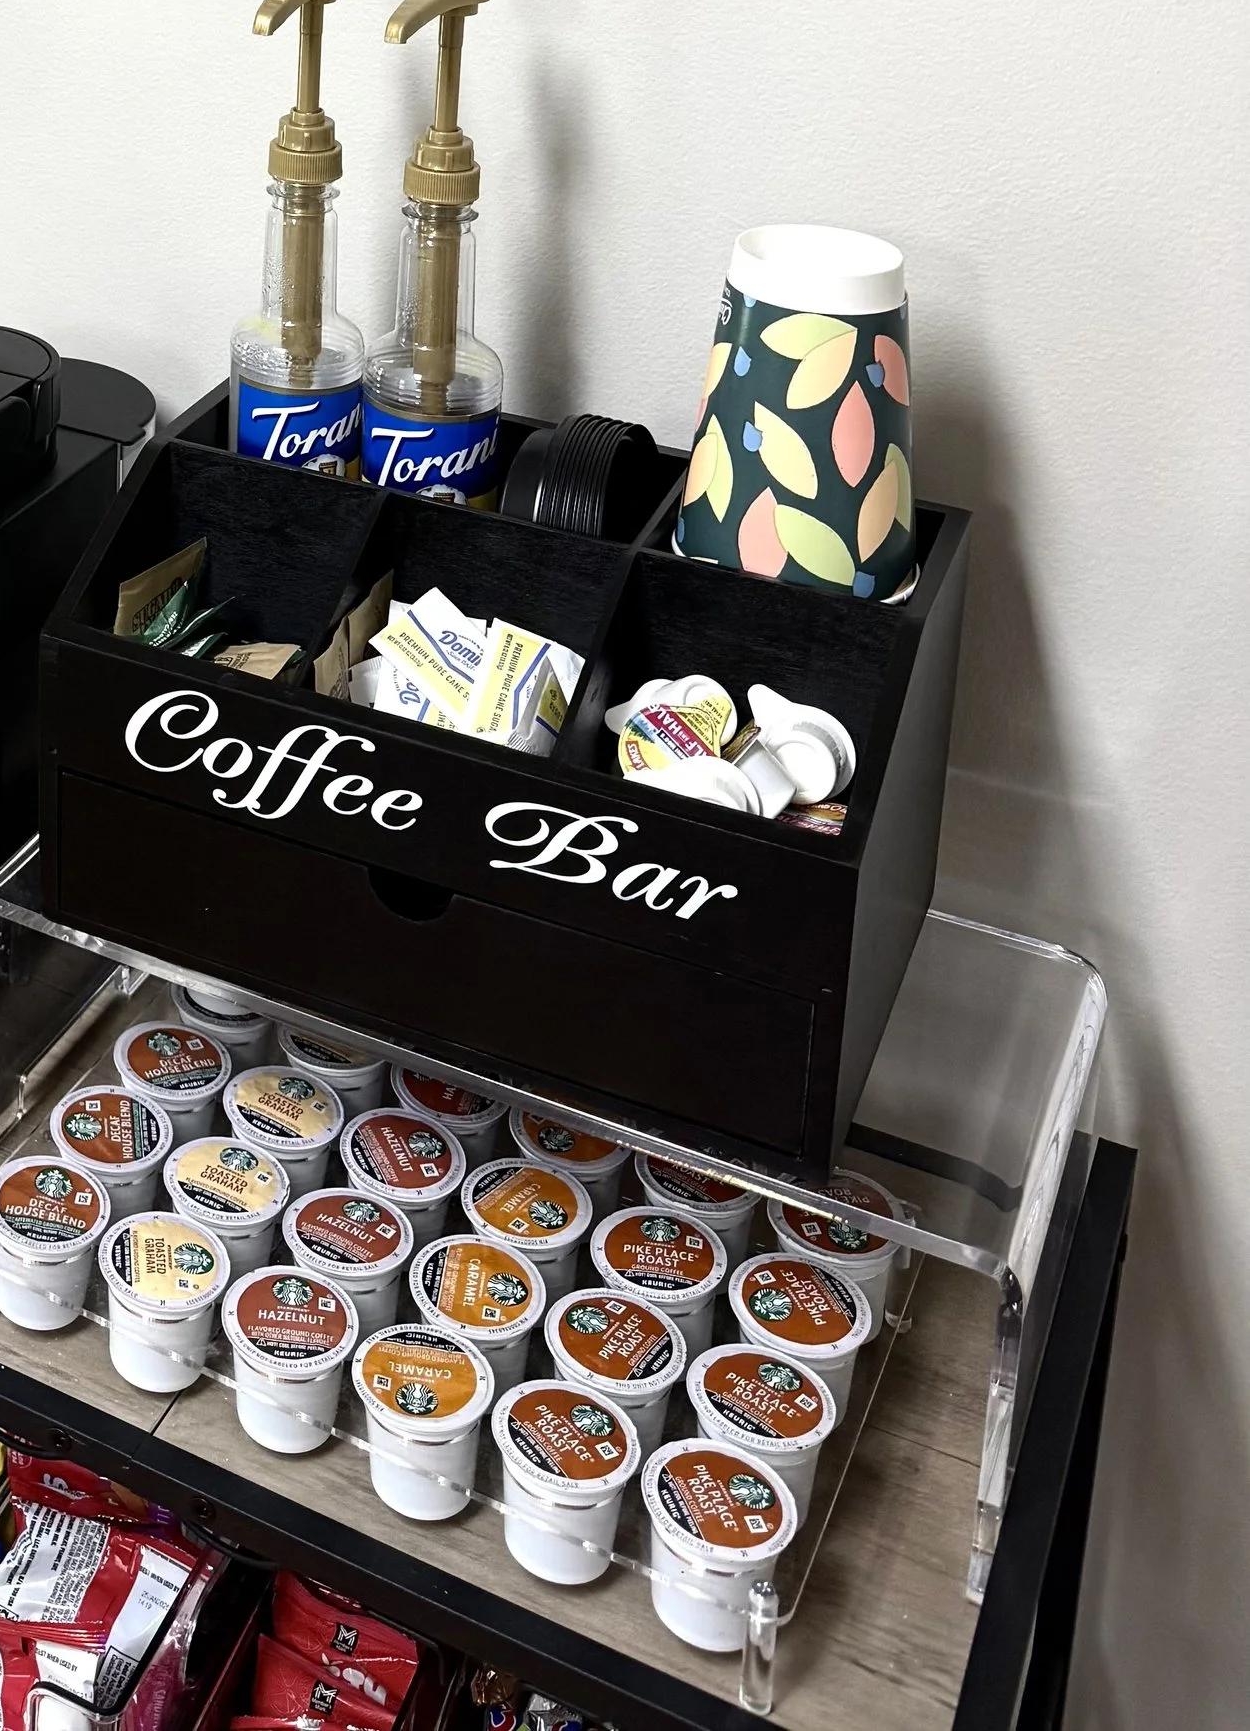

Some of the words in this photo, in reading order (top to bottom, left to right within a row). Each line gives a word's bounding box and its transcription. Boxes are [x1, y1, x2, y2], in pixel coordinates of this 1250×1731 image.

[251, 400, 361, 461] Toran
[371, 416, 499, 487] Torani
[400, 632, 430, 661] PREMIUM
[429, 658, 448, 676] PURE
[445, 674, 463, 692] CANE
[507, 642, 523, 677] PREMIUM
[503, 676, 513, 698] PURE
[497, 696, 509, 715] CANE
[124, 689, 424, 831] Coffee
[484, 801, 739, 921] Bar
[144, 1065, 182, 1079] HOUSE
[182, 1059, 216, 1072] BLEND
[159, 1055, 193, 1067] DECAF
[180, 1081, 205, 1089] KEURIG
[120, 1100, 131, 1128] BLEND
[258, 1096, 300, 1121] GRAHAM
[263, 1093, 304, 1115] TOASTED
[110, 1115, 121, 1142] DECAF
[252, 1119, 280, 1134] KEURIG
[122, 1128, 134, 1159] HOUSE
[381, 1127, 413, 1172] HAZELNUT
[200, 1172, 244, 1195] GRAHAM
[205, 1165, 248, 1188] TOASTED
[500, 1183, 542, 1213] CARAMEL
[663, 1181, 692, 1198] KEURIG
[29, 1198, 68, 1214] DECAF
[195, 1194, 224, 1210] KEURIG
[5, 1205, 48, 1220] HOUSE
[47, 1213, 87, 1229] BLEND
[316, 1213, 376, 1244] HAZELNUT
[26, 1232, 58, 1242] KEURIG
[49, 1242, 62, 1250] FOR
[145, 1238, 156, 1274] GRAHAM
[155, 1238, 166, 1275] TOASTED
[312, 1245, 341, 1260] KEURIG
[623, 1244, 652, 1255] PIKE
[655, 1247, 695, 1262] PLACE
[637, 1254, 680, 1268] ROAST
[425, 1263, 434, 1286] KEURIG
[631, 1264, 660, 1272] GROUND
[660, 1267, 684, 1276] COFFEE
[463, 1258, 481, 1307] CARAMEL
[642, 1280, 675, 1289] KEURIG
[786, 1270, 810, 1300] PLACE
[801, 1280, 830, 1312] ROAST
[258, 1310, 325, 1326] HAZELNUT
[802, 1300, 827, 1326] PIKE
[248, 1325, 281, 1334] FLAVORED
[282, 1328, 310, 1337] GROUND
[310, 1332, 334, 1342] COFFEE
[406, 1332, 437, 1343] KEURIG
[598, 1336, 622, 1360] PIKE
[619, 1314, 642, 1343] PLACE
[617, 1329, 646, 1357] ROAST
[389, 1361, 452, 1379] CARAMEL
[651, 1349, 670, 1372] KEURIG
[722, 1391, 750, 1409] GROUND
[726, 1372, 756, 1392] PIKE
[755, 1389, 796, 1418] PLACE
[733, 1387, 776, 1415] ROAST
[723, 1409, 756, 1431] KEURIG
[535, 1404, 562, 1427] PIKE
[557, 1424, 592, 1462] PLACE
[535, 1419, 571, 1452] ROAST
[515, 1437, 541, 1464] KEURIG
[660, 1489, 681, 1519] KEURIG
[687, 1478, 717, 1516] ROAST
[693, 1464, 715, 1489] PIKE
[711, 1488, 735, 1529] PLACE
